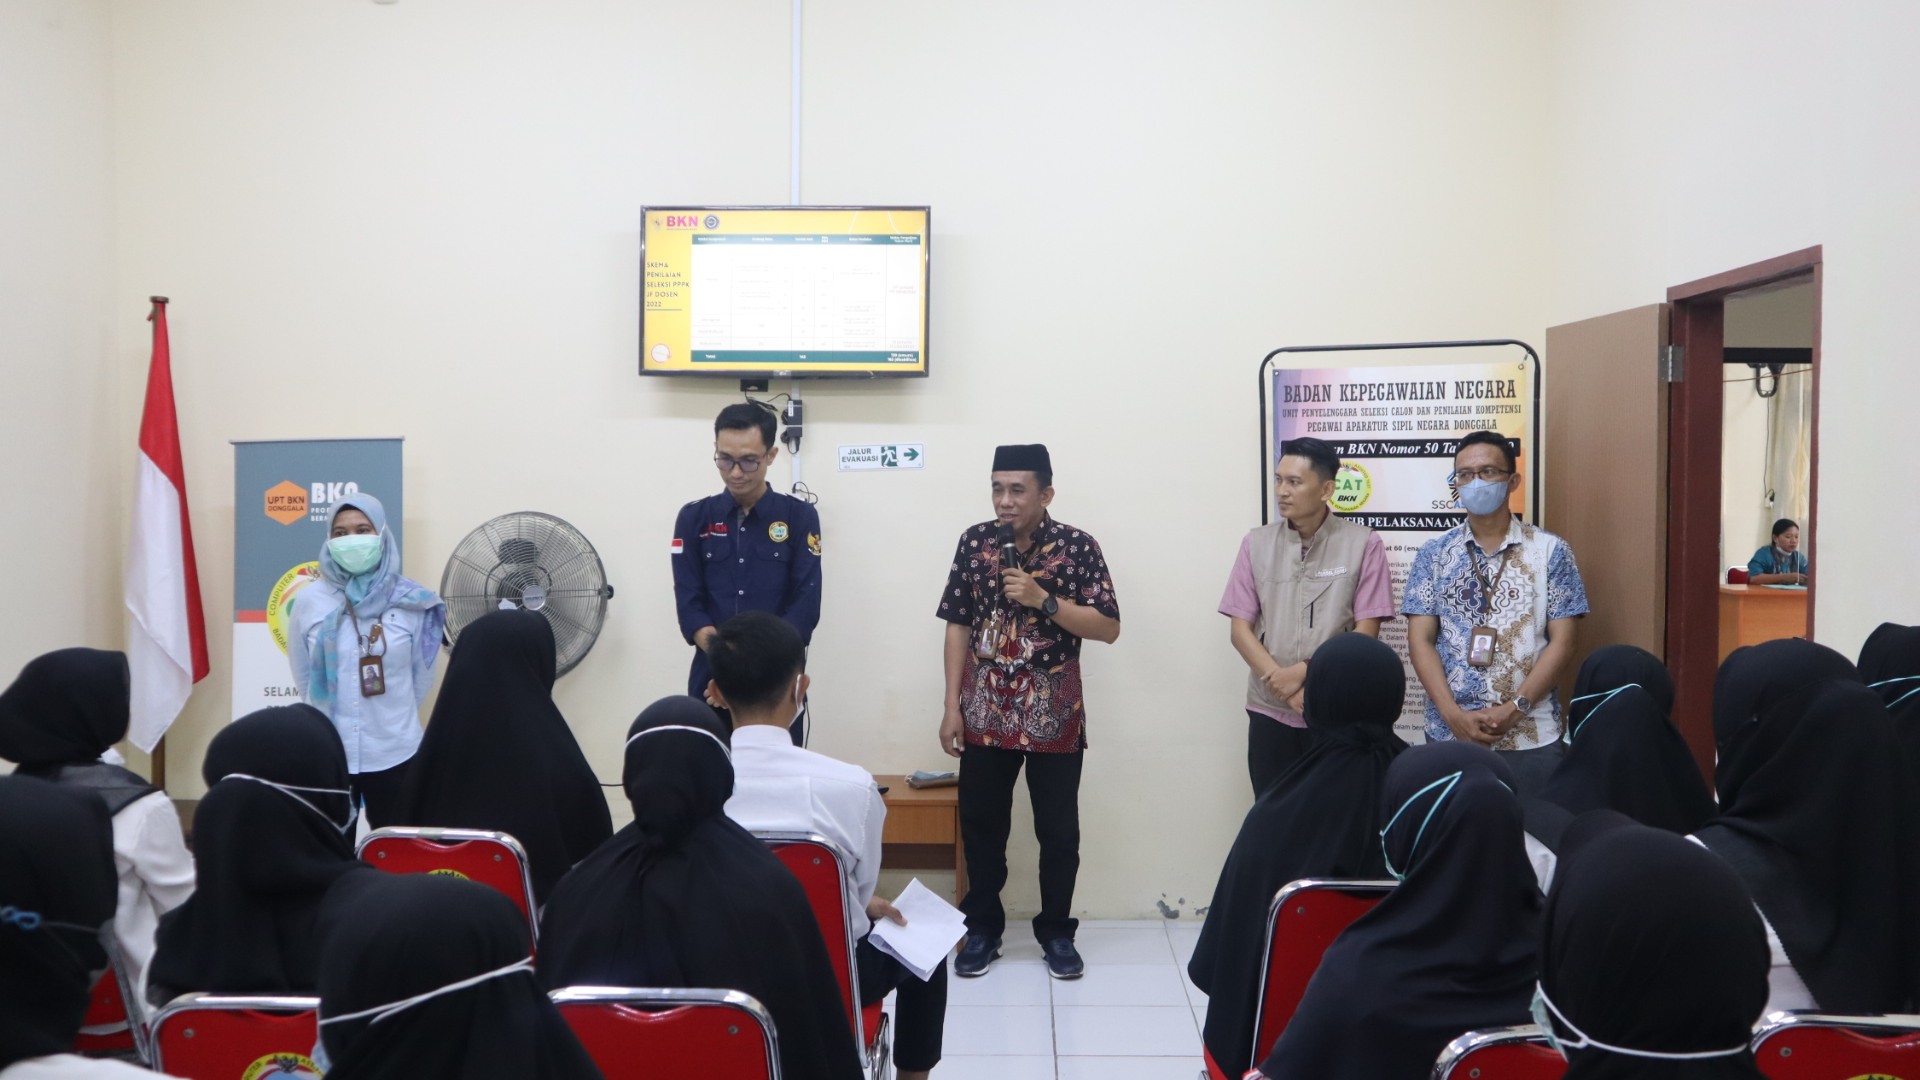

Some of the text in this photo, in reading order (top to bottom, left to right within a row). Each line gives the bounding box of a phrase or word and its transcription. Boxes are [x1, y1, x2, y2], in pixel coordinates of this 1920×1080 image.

[667, 216, 698, 227] BKN
[1284, 379, 1516, 403] BADAN KEPEGAWAIAN NEGARA
[1282, 404, 1521, 418] UNIT PENYELENGGARA SELEKSI CALON DAN PENILAIAN KOMPETENSI
[1307, 419, 1497, 432] PEGAWAI APARATUR SIPIL NEGARA DONGGALA
[1347, 442, 1378, 454] BKN
[1379, 442, 1421, 454] Nomor
[1424, 442, 1439, 454] 50
[841, 455, 879, 463] EVAKUASI
[267, 496, 305, 504] UPT BKN
[1367, 517, 1460, 527] PELAKSANAAN
[269, 573, 294, 616] COMPUTER
[272, 628, 288, 649] BADA
[263, 686, 301, 697] SELAM
